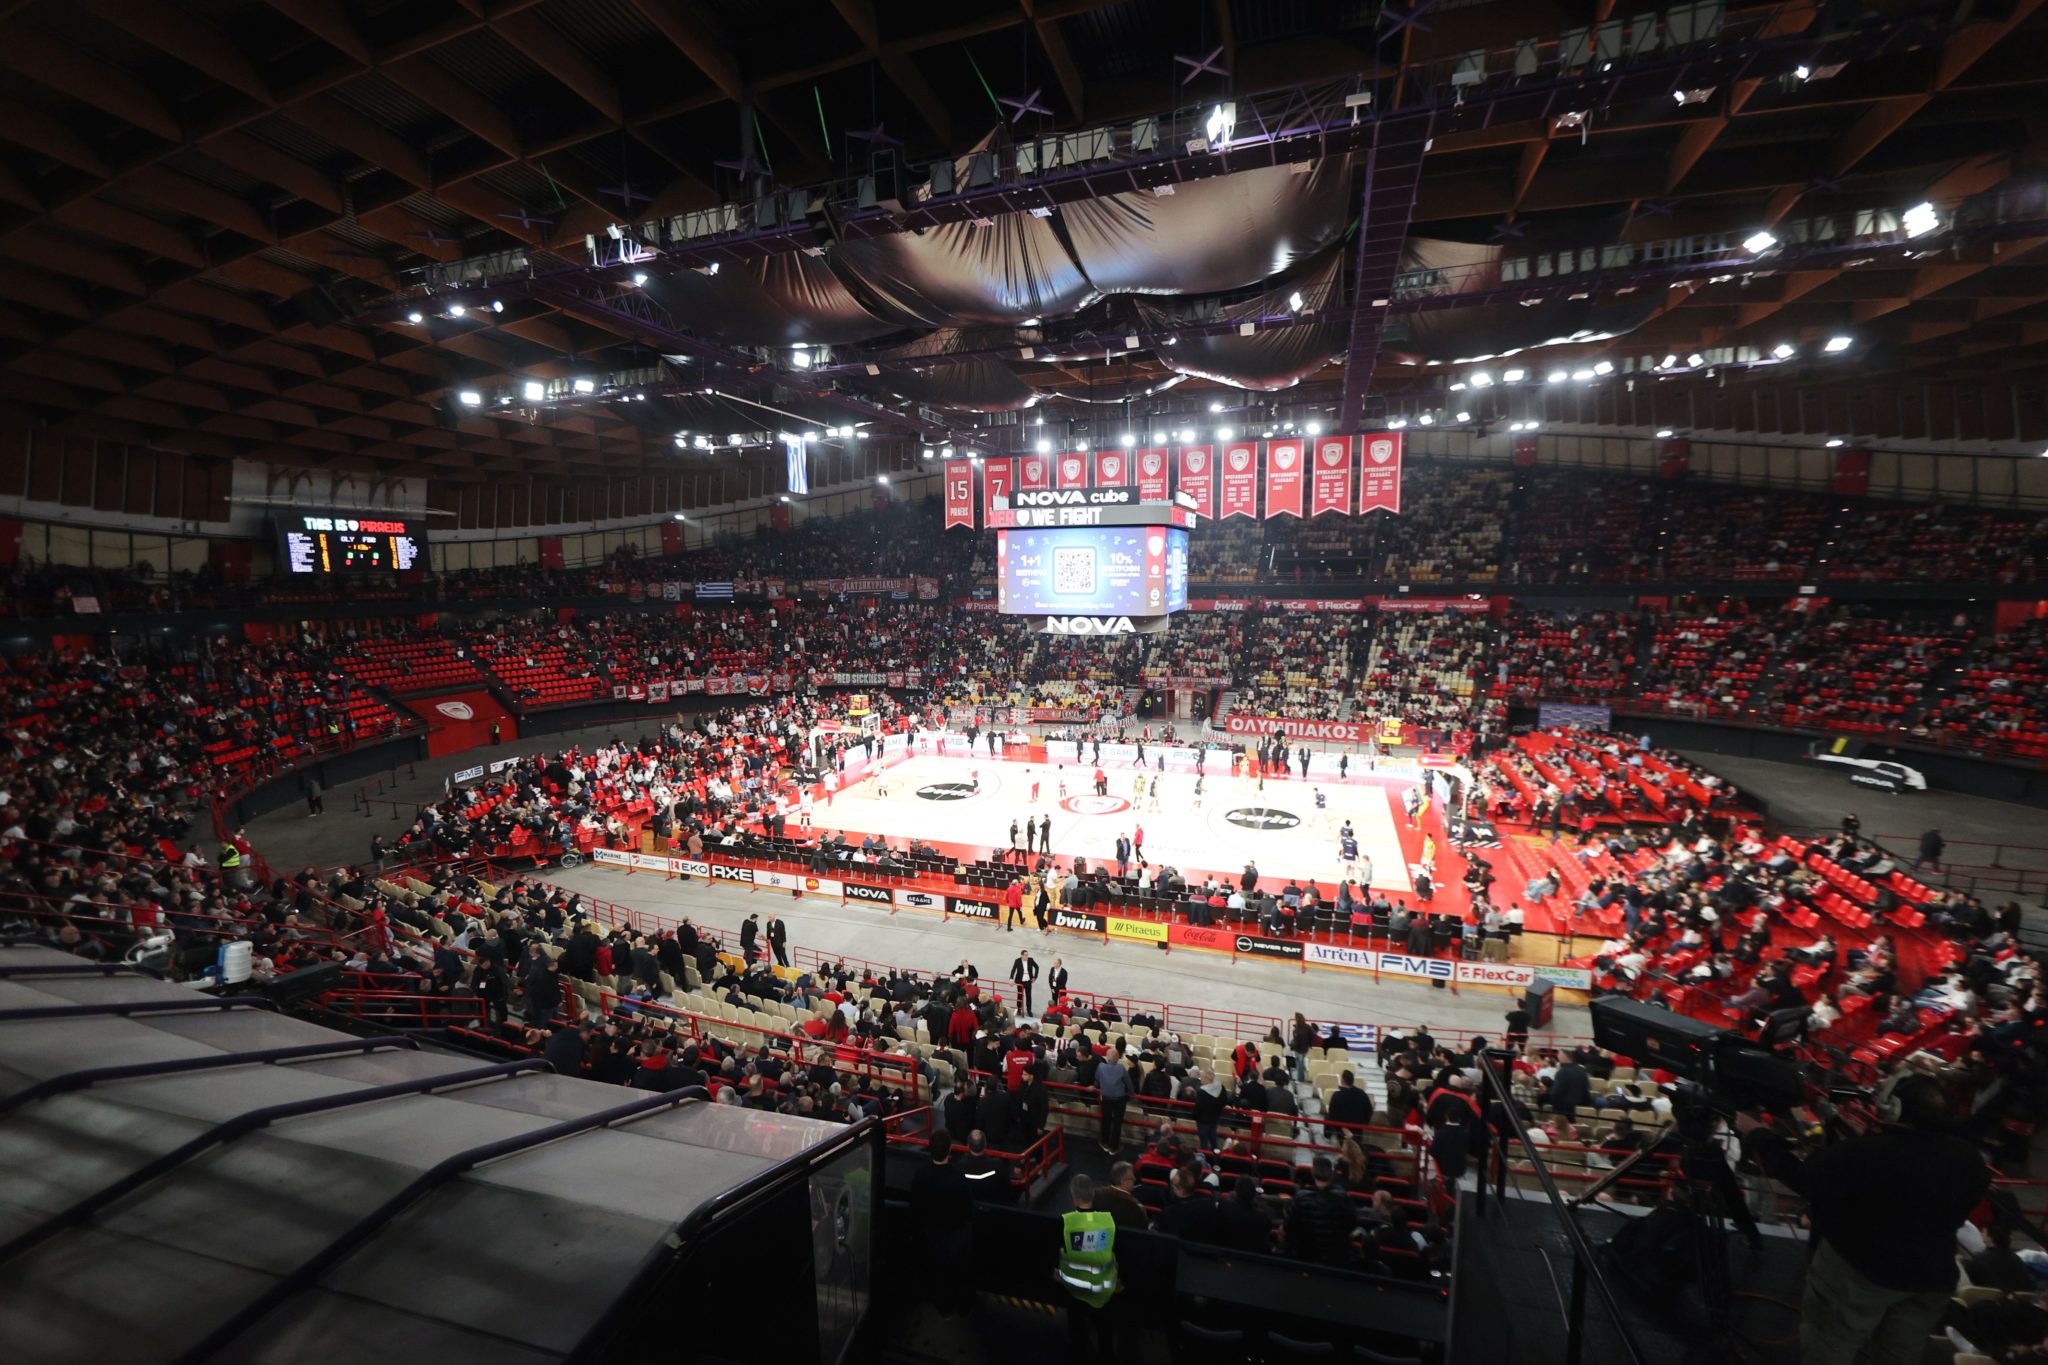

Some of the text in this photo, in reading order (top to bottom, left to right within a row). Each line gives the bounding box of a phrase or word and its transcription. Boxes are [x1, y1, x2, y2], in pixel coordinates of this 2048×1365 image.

[950, 480, 968, 501] 15
[992, 479, 1003, 496] 7
[1017, 489, 1129, 506] NOVA cube
[1032, 509, 1055, 526] WE
[1060, 508, 1102, 525] FIGHT
[303, 517, 405, 533] THIS IS PIRAEUS
[1020, 554, 1041, 567] 1+1
[1109, 552, 1133, 565] 10%
[1214, 600, 1243, 611] bwin
[1325, 601, 1360, 610] FlexCar
[1046, 616, 1136, 633] NOVA
[1231, 718, 1360, 740] ΟΛΥΜΠΙΑΚΟΣ
[1383, 727, 1399, 736] 24
[456, 766, 483, 780] FMS
[1226, 811, 1300, 826] bwin
[681, 862, 708, 874] EKO
[711, 866, 752, 882] AXE
[846, 886, 890, 901] NOVA
[955, 900, 992, 918] bwin
[1055, 912, 1098, 931] bwin
[1126, 923, 1161, 937] Piraeus
[1254, 943, 1281, 952] NEVER
[1282, 945, 1302, 954] QUIT
[1381, 955, 1451, 977] FMS
[1473, 968, 1530, 983] FlexCar
